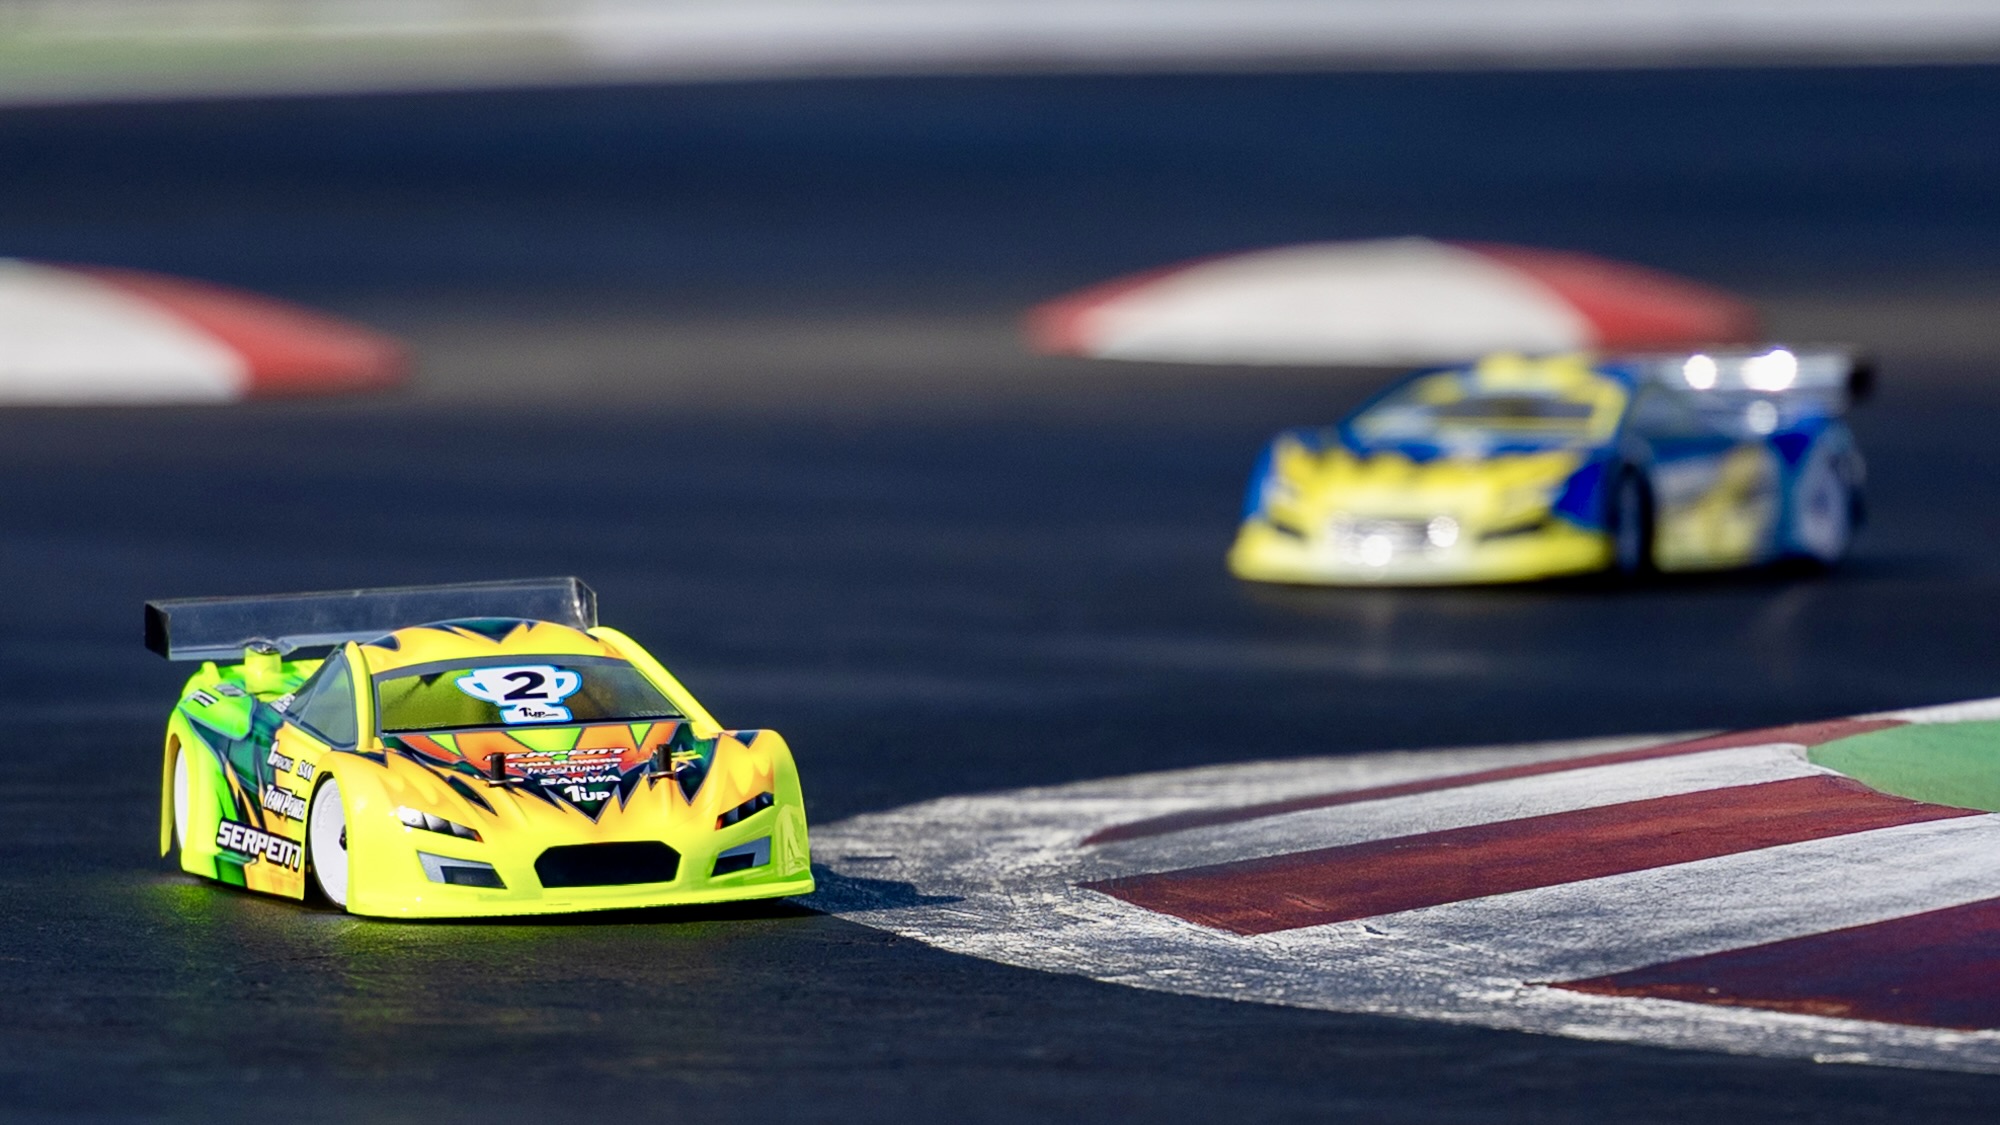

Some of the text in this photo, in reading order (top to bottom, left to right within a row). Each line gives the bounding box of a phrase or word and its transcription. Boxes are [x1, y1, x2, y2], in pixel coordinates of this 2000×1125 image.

[502, 671, 548, 701] 2
[539, 774, 622, 786] SANWA
[216, 820, 302, 869] SERPENT
